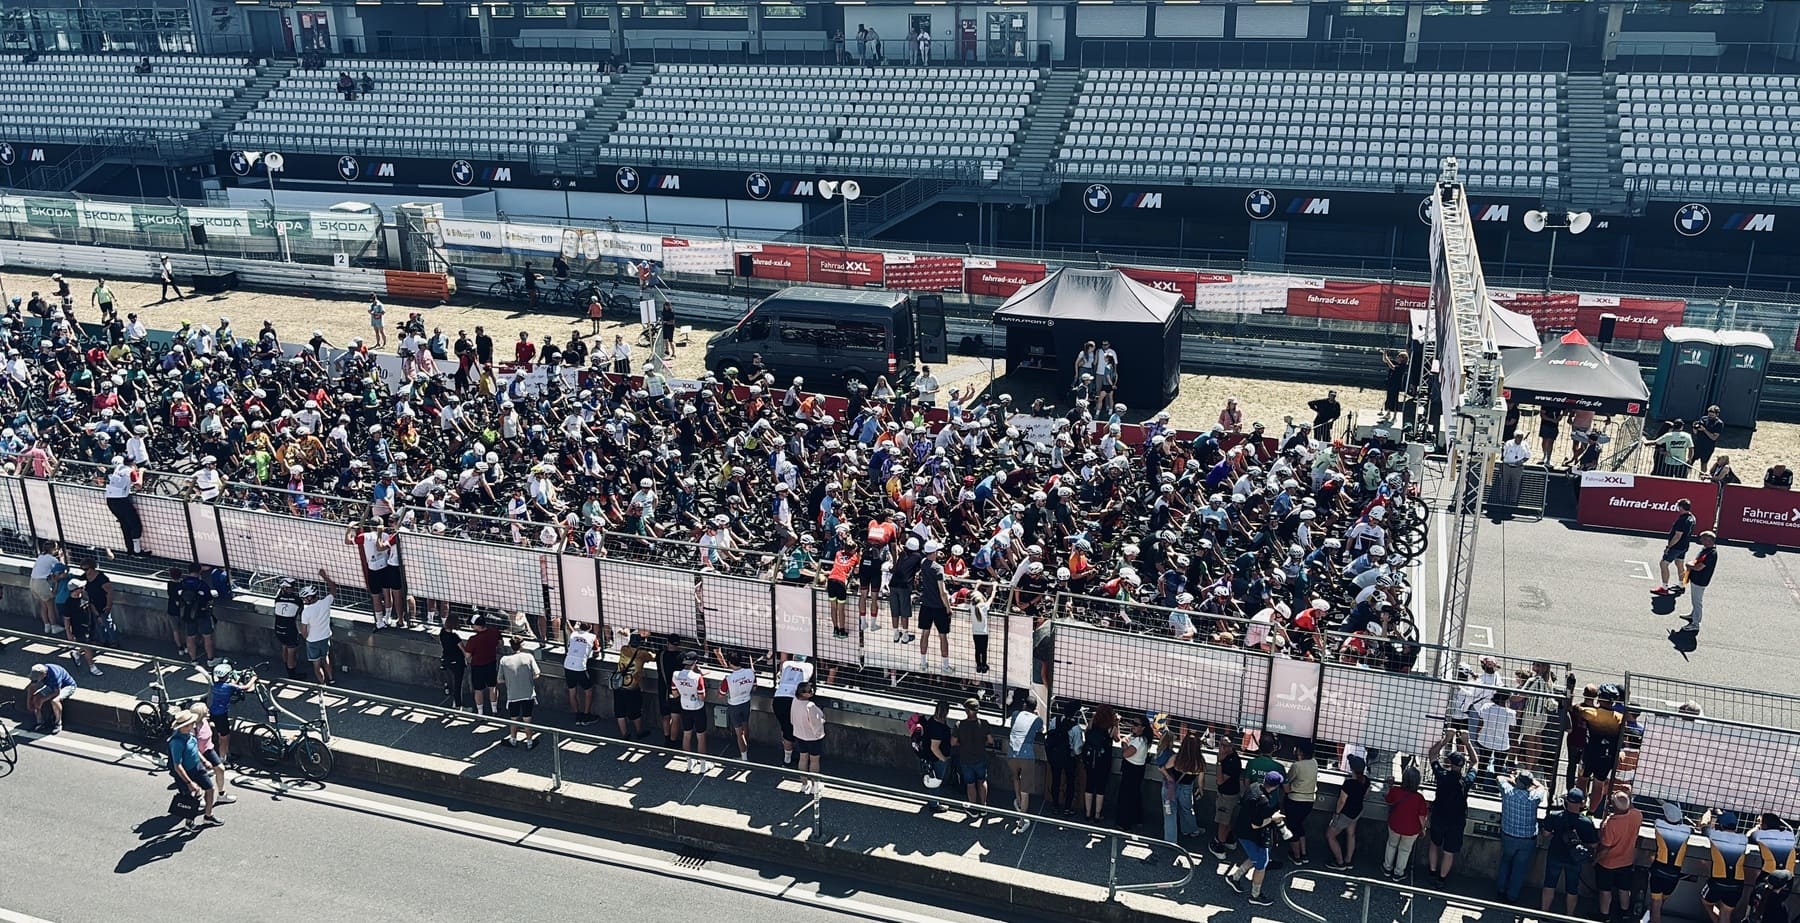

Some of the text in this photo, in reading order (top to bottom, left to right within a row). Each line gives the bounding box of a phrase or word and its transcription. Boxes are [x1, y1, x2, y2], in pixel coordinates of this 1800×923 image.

[494, 167, 512, 182] M
[661, 175, 680, 189] M
[794, 181, 814, 196] M
[1139, 193, 1163, 208] M
[1304, 198, 1330, 215] M
[1481, 205, 1510, 221] M
[1744, 214, 1776, 231] M
[338, 254, 345, 263] 2
[821, 261, 871, 272] Fahrrad XXL
[982, 274, 1027, 285] fahrrad-xxl.de
[1153, 281, 1182, 292] XXL
[1308, 295, 1360, 306] fahrrad-xxl.de
[1494, 291, 1511, 299] XXL
[1395, 298, 1427, 309] Fahrrad
[1604, 476, 1627, 485] XXL
[1743, 507, 1789, 521] Fahrrad
[1742, 517, 1785, 527] DEUTSCHLANDS
